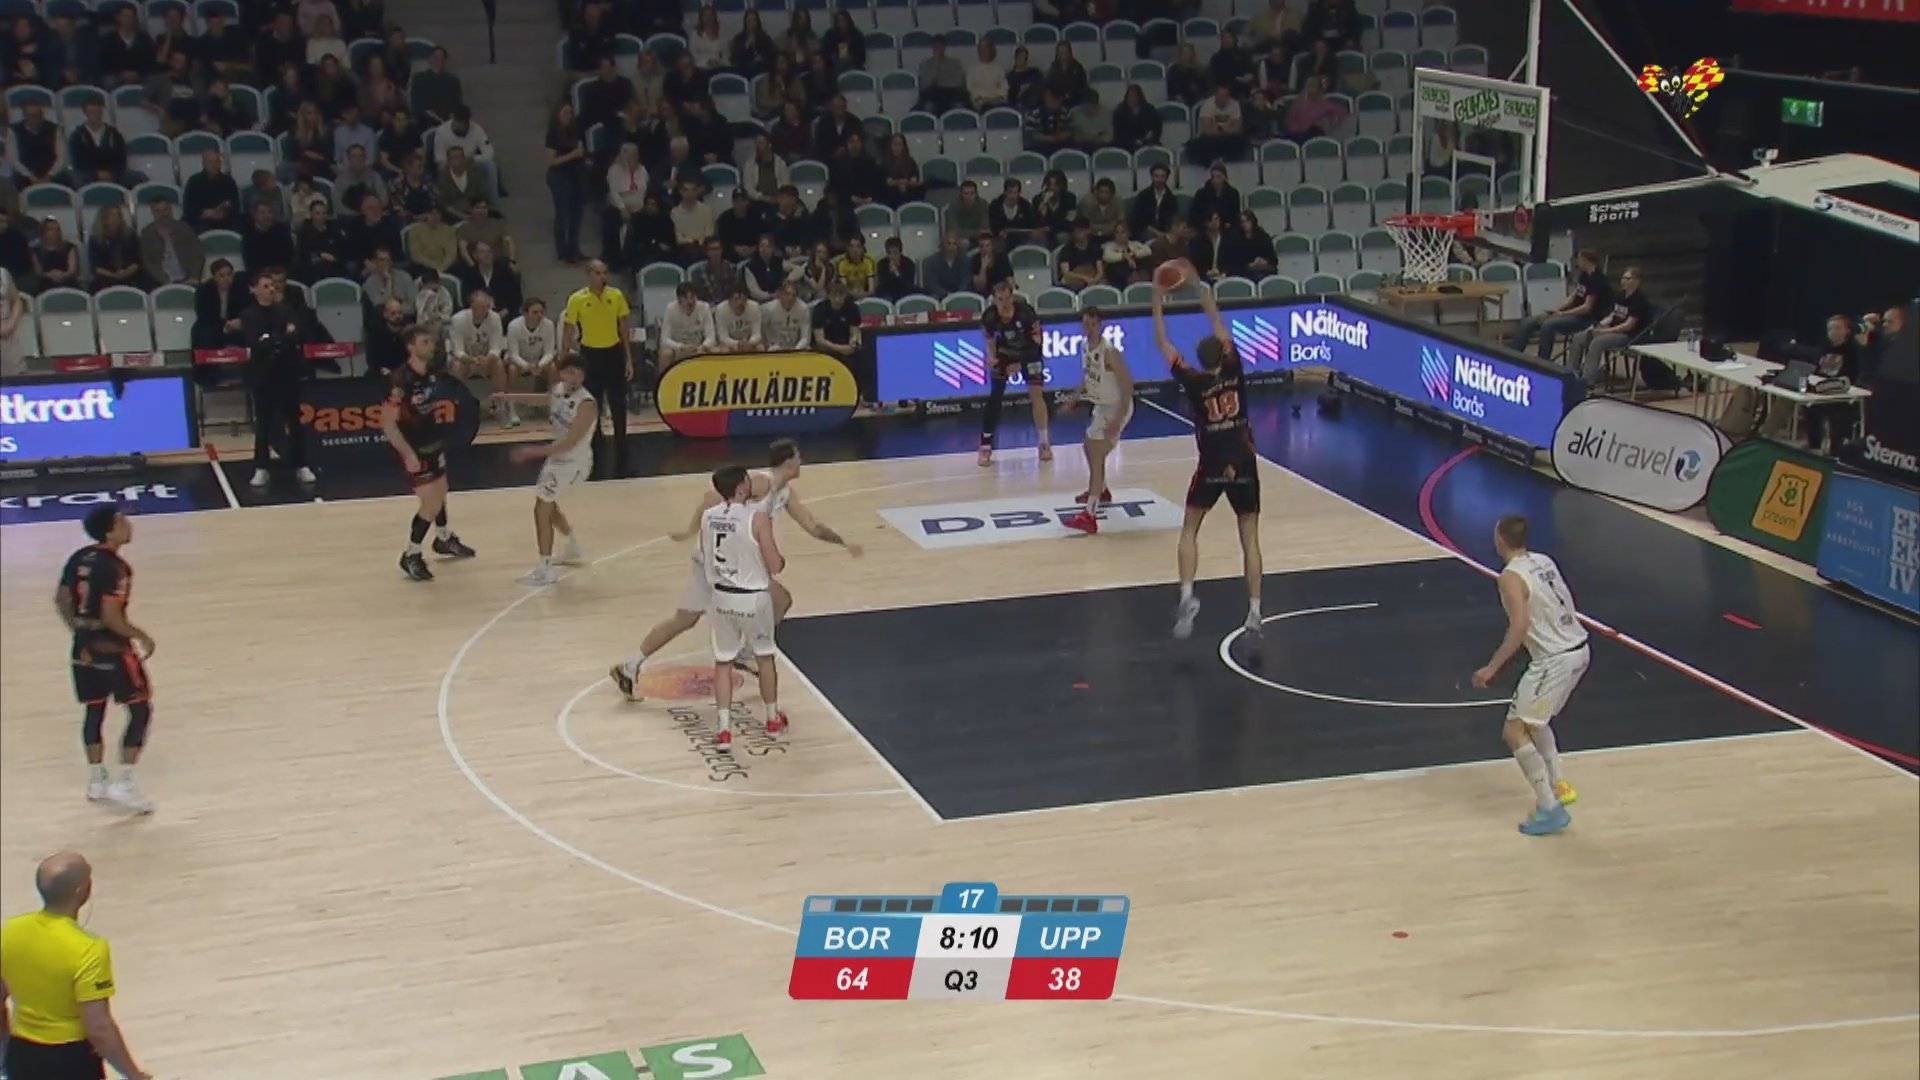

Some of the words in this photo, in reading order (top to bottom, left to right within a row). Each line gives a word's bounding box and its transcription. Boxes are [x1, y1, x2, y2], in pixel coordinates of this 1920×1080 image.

[1290, 309, 1368, 349] Nätkraft
[680, 372, 832, 408] BLÅKLÄDER
[1455, 354, 1531, 407] Nätkraft
[746, 407, 816, 417] WORKWEAR
[1453, 388, 1485, 418] Borås
[322, 435, 370, 446] SECURITY
[1568, 427, 1606, 460] aki
[1606, 432, 1675, 476] travel
